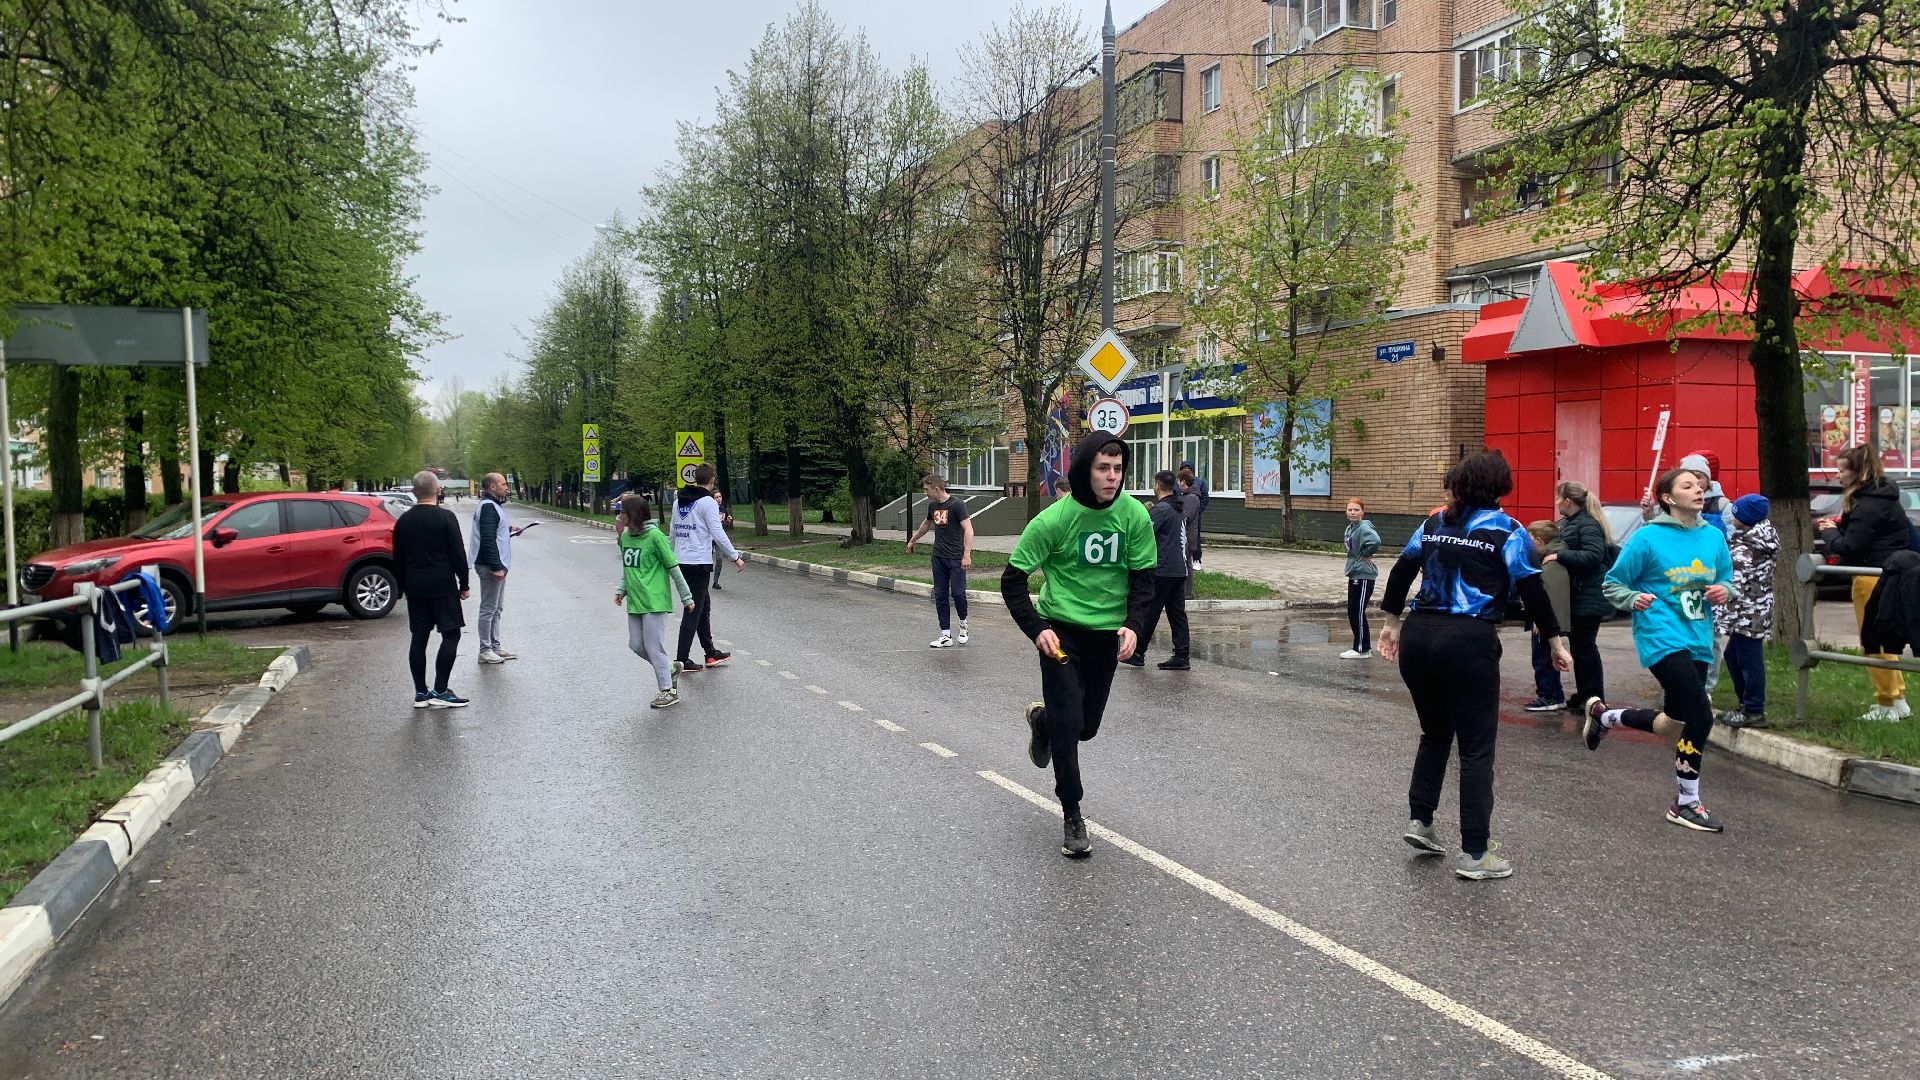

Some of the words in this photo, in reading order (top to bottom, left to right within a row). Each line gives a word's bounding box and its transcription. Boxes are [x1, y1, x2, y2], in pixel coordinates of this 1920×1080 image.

[1391, 353, 1399, 362] 21
[1855, 378, 1866, 445] ЛЬМЕНИ
[933, 509, 949, 526] 34
[623, 547, 641, 567] 61
[1084, 532, 1119, 564] 61
[1680, 590, 1705, 620] 62
